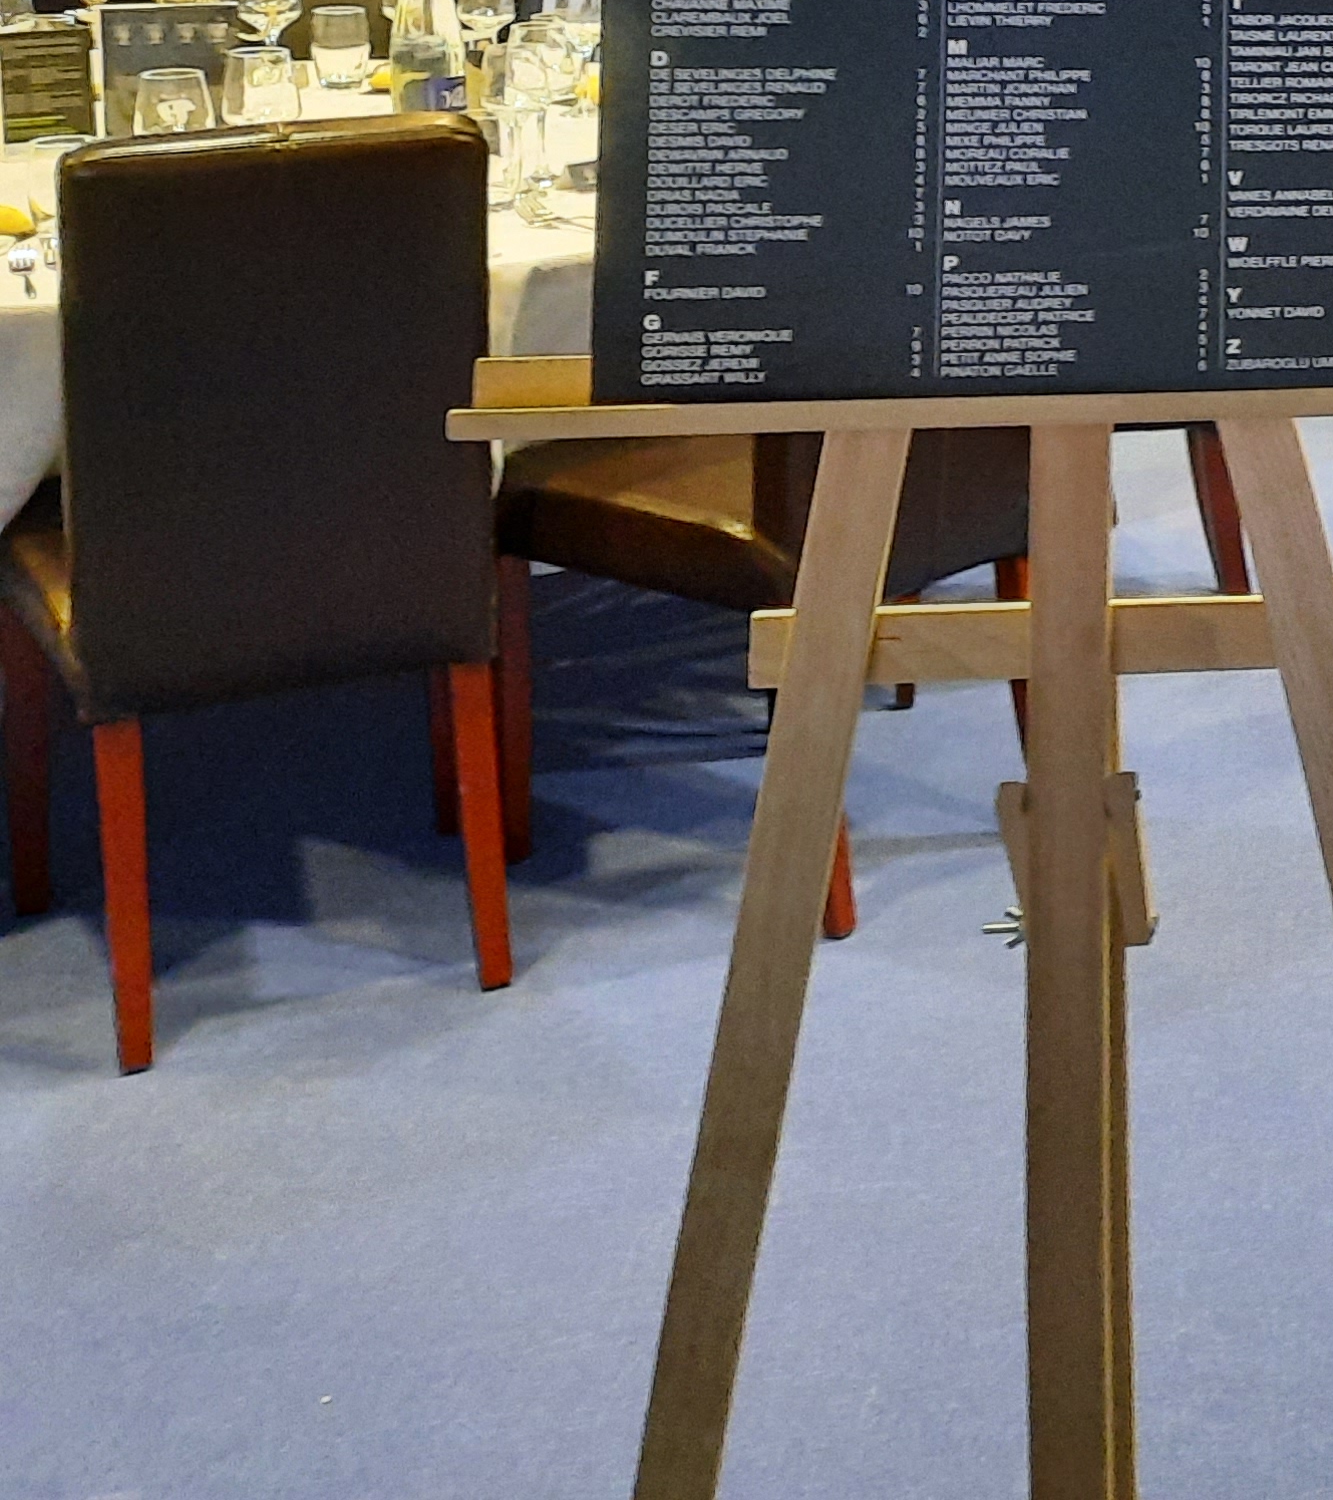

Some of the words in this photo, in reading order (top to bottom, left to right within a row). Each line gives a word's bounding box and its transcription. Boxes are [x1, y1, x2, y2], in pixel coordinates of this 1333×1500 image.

[948, 39, 967, 54] M
[650, 51, 670, 66] D
[1228, 171, 1243, 185] V
[945, 200, 961, 215] N
[1228, 237, 1248, 252] W
[943, 256, 959, 270] P
[645, 270, 660, 285] F
[1226, 288, 1242, 303] Y
[643, 315, 661, 329] G
[1226, 339, 1241, 354] Z
